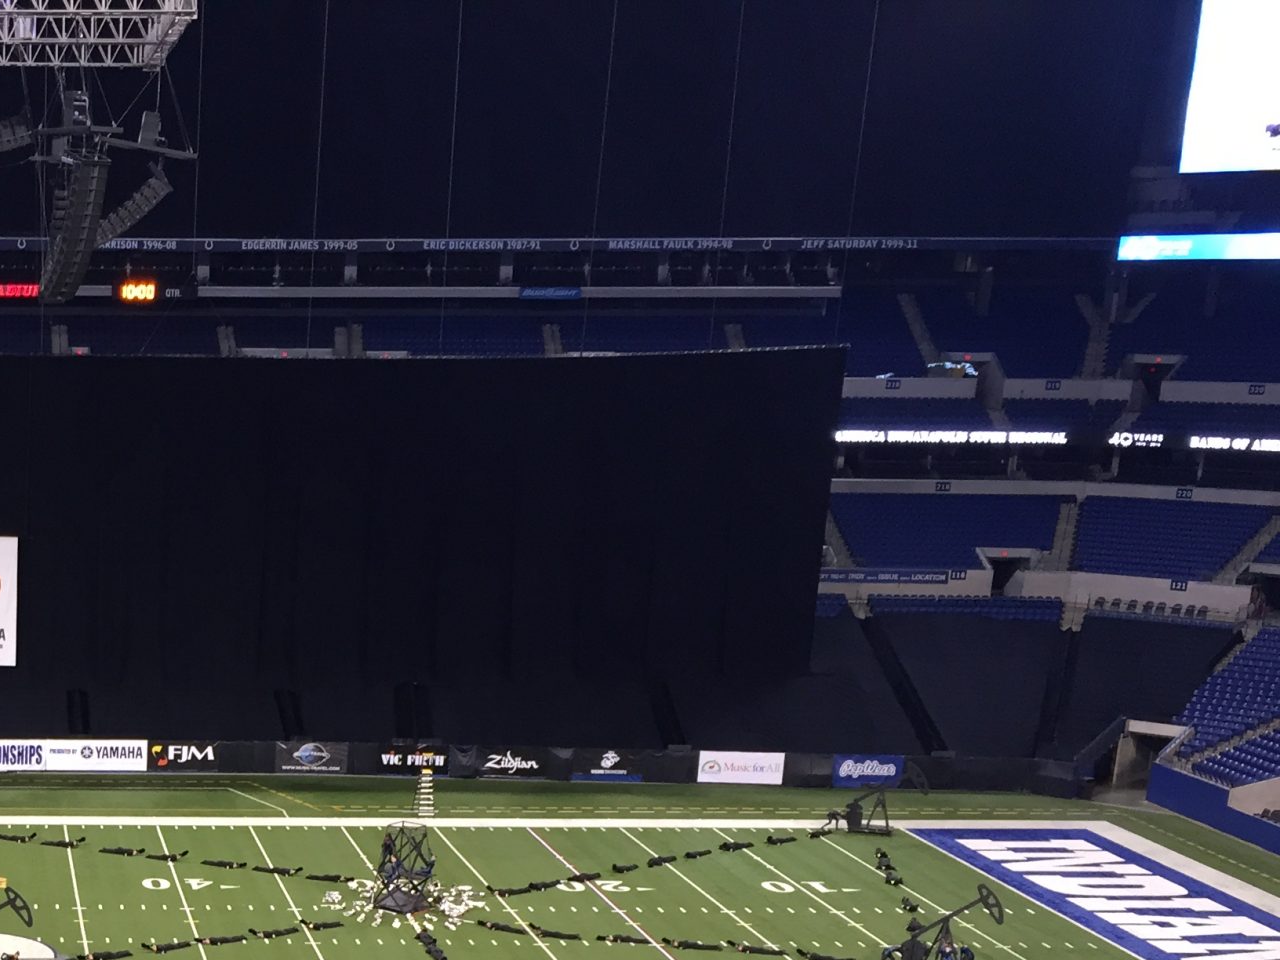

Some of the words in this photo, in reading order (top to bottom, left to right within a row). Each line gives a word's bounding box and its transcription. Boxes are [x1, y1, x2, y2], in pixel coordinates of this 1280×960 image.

[143, 240, 177, 250] 1996-08
[242, 240, 287, 250] EDGERRIN
[288, 240, 319, 250] JAMES
[323, 241, 358, 250] 1999-05
[423, 240, 446, 250] ERIC
[449, 240, 504, 250] DICKERSON
[506, 240, 541, 250] 1987-91
[609, 240, 661, 249] MARSHALL
[663, 240, 694, 249] FAULK
[696, 240, 733, 250] 1994-98
[801, 239, 825, 249] JEFF
[827, 239, 878, 249] SATURDAY
[881, 239, 918, 249] 1999-11
[95, 746, 143, 759] YAMAHA
[168, 745, 215, 762] FJM
[485, 751, 539, 774] Zildjian
[724, 762, 752, 772] Music
[753, 762, 765, 772] for
[766, 762, 780, 773] All
